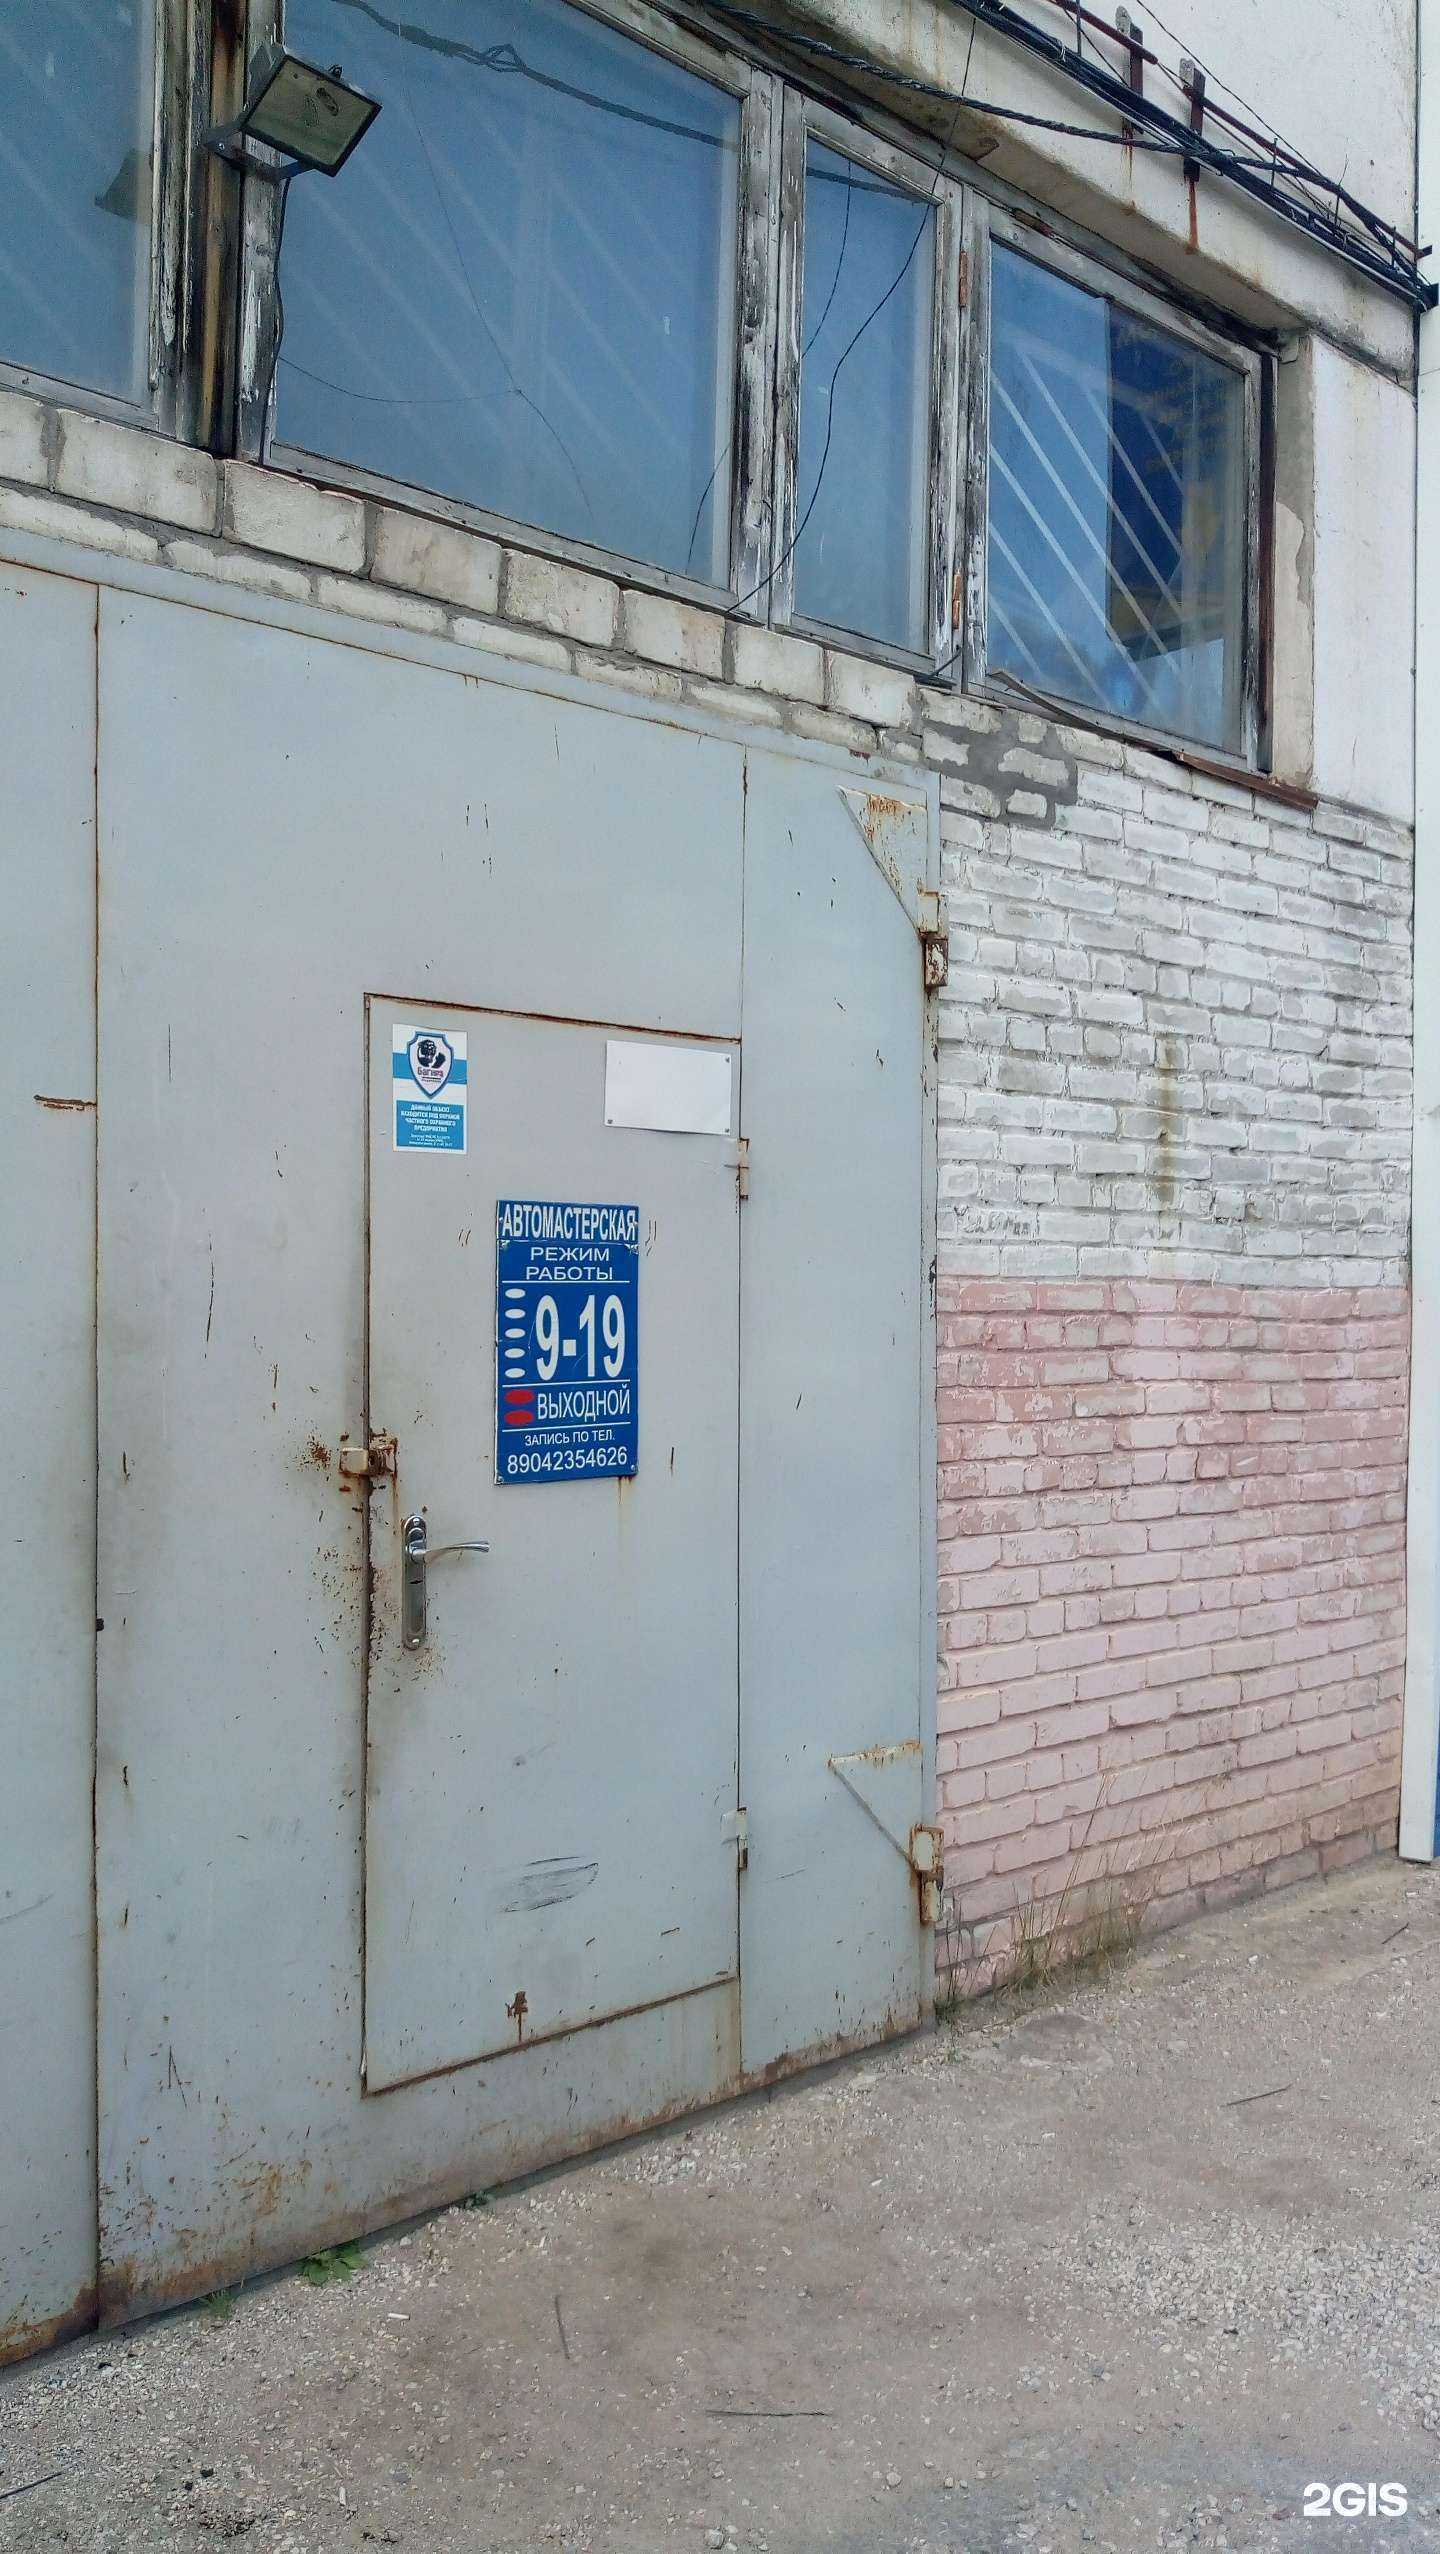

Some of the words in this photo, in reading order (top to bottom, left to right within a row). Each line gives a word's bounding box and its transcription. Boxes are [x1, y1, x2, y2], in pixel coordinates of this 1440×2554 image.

[502, 1204, 636, 1241] АВТОМАСТЕРСКАЯ
[530, 1246, 610, 1262] РЕЖИМ
[525, 1266, 613, 1280] РАБОТЫ
[535, 1294, 626, 1381] 9-19
[537, 1383, 631, 1422] ВЫХОДНОЙ
[524, 1431, 570, 1447] ЗАПИСЬ
[573, 1431, 589, 1443] ПО
[592, 1429, 616, 1441] ТЕЛ.
[507, 1446, 628, 1474] 89042354626
